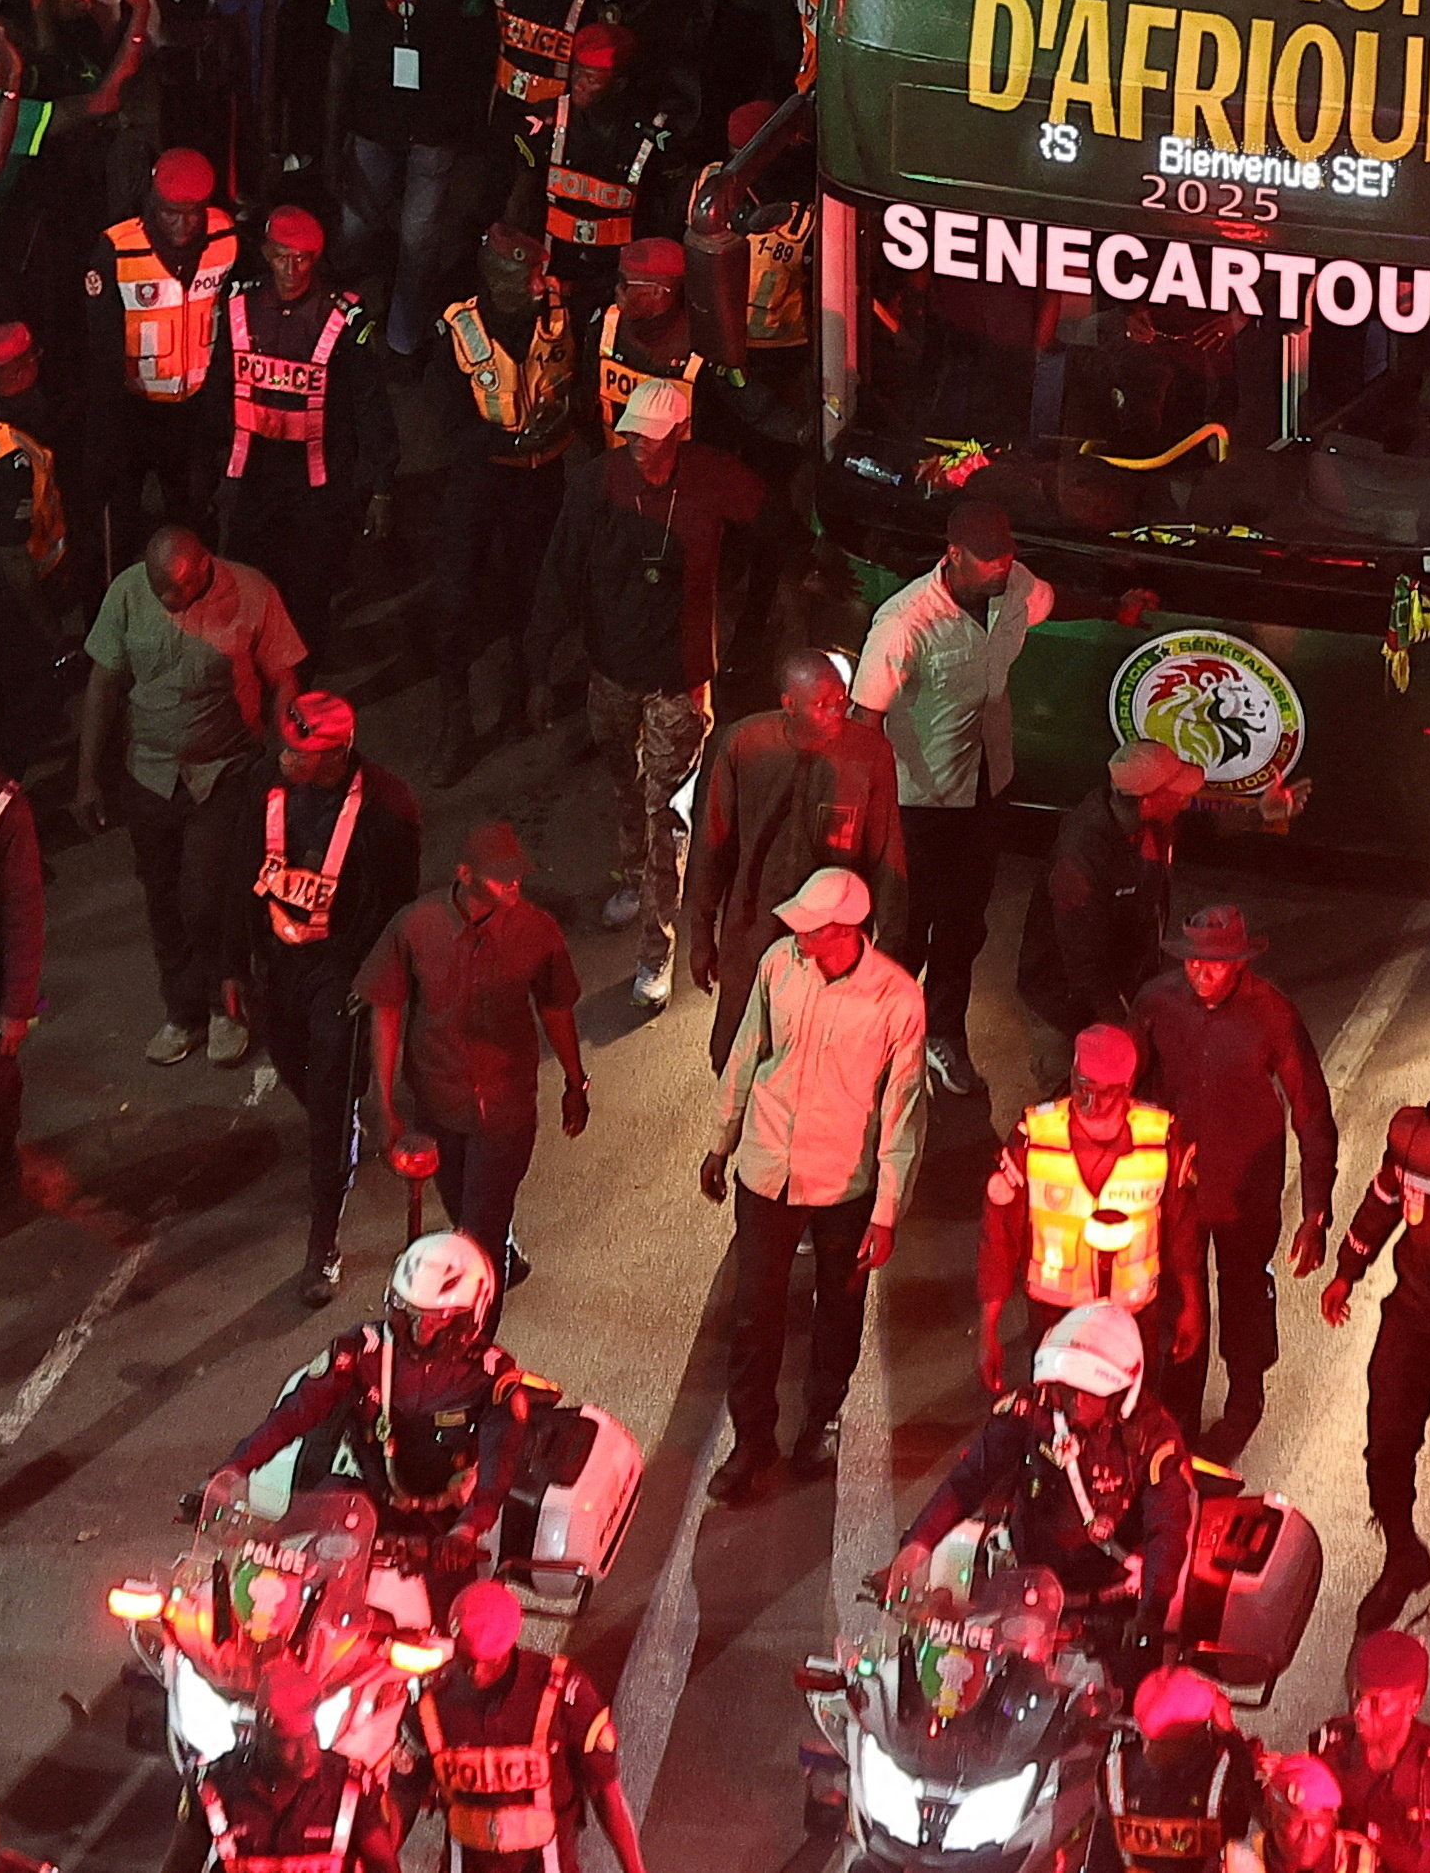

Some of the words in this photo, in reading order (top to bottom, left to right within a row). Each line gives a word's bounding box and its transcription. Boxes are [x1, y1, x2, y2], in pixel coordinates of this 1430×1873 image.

[1158, 134, 1322, 191] Bienvenue
[549, 168, 632, 206] POLICE
[1140, 173, 1280, 223] 2025
[756, 237, 794, 264] 1-89
[237, 357, 322, 391] POLICE
[1178, 636, 1292, 714] SÉNÉGALAISE
[1274, 739, 1291, 761] DE
[241, 1538, 308, 1576] POLICE
[929, 1616, 995, 1652] POLICE
[443, 1760, 542, 1793] POLICE
